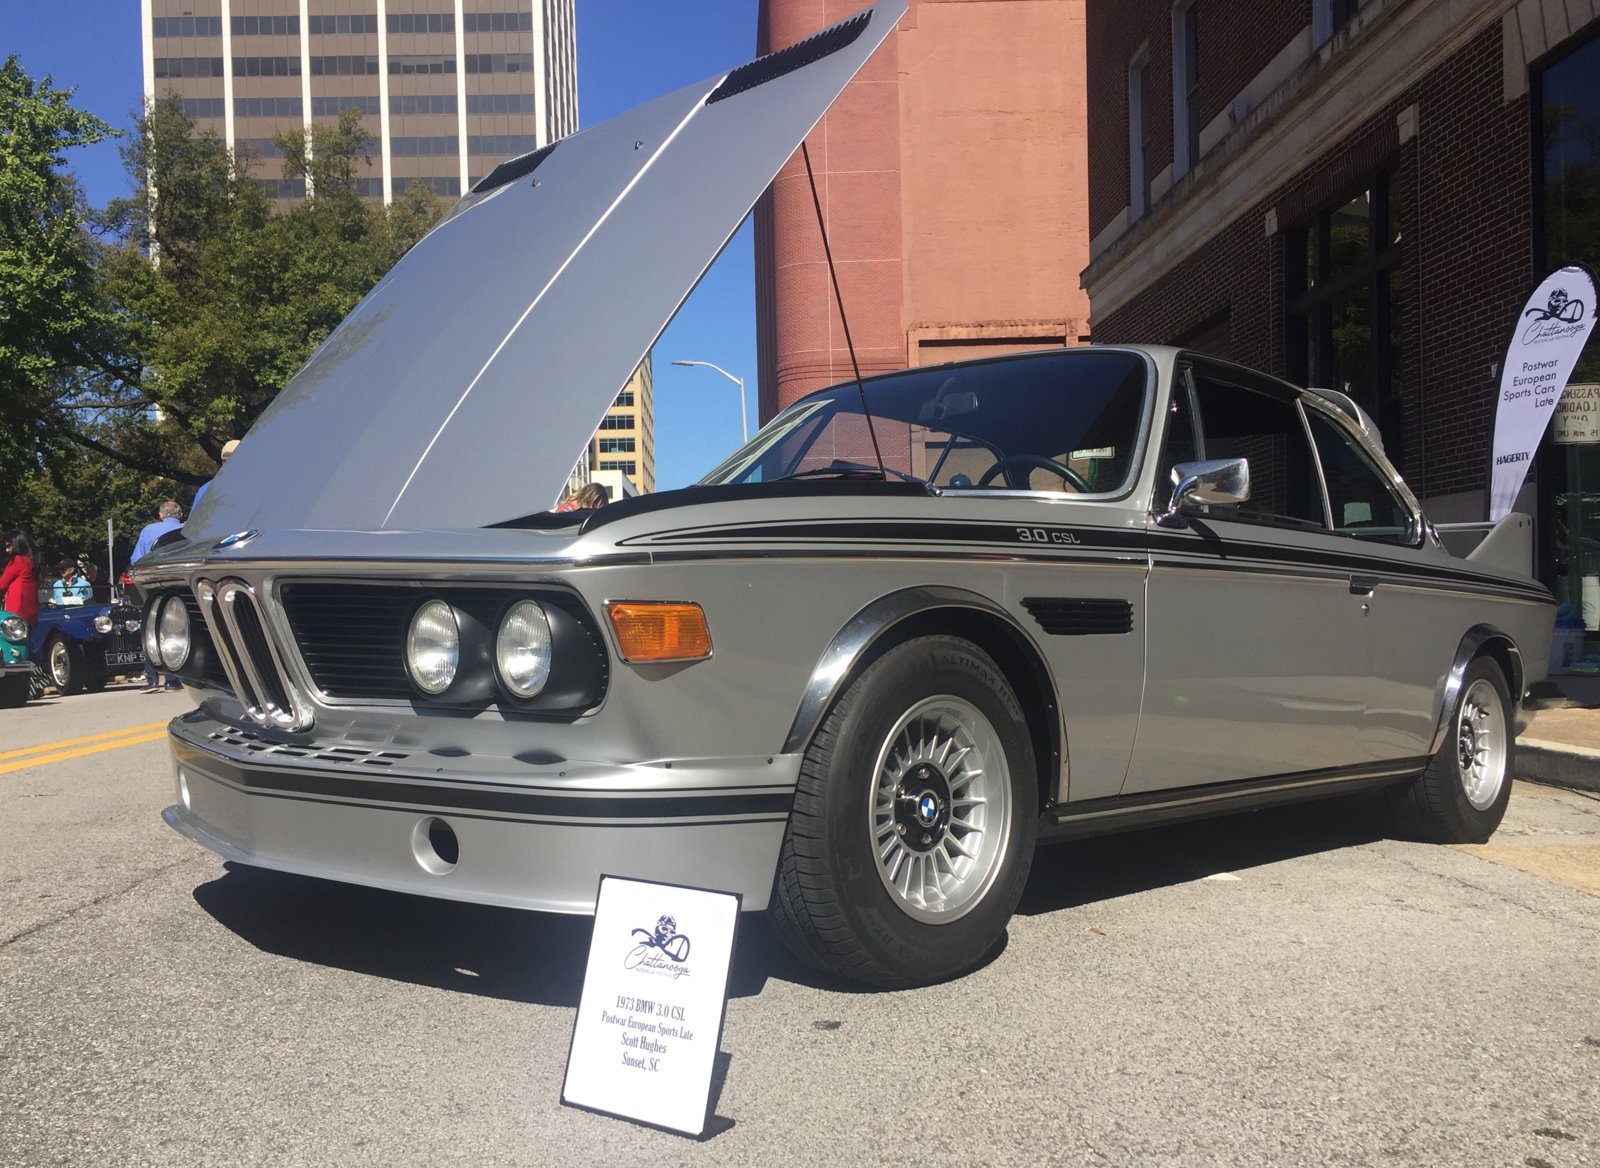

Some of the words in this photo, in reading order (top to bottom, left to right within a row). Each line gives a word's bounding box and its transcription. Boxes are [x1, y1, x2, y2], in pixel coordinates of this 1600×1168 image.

[1522, 320, 1586, 345] Chattanooga
[1522, 359, 1559, 373] Postwar
[1513, 372, 1557, 387] European
[1503, 388, 1532, 403] Sports
[1534, 384, 1556, 396] Cars
[1535, 397, 1554, 408] Late
[1496, 451, 1530, 466] HAGERTY
[1016, 527, 1049, 542] 3.0
[1051, 532, 1081, 544] CSL
[117, 653, 137, 663] KNP
[942, 655, 996, 684] ALTIMAX
[623, 944, 691, 980] Chattanooga
[616, 995, 635, 1011] 1973
[635, 998, 656, 1015] BMW
[656, 1003, 670, 1018] 3.0
[671, 1005, 685, 1021] CSL
[601, 1010, 627, 1026] Postwar
[627, 1015, 657, 1032] European
[657, 1022, 679, 1037] Sports
[679, 1026, 694, 1041] Late
[621, 1031, 639, 1048] Scott
[639, 1035, 667, 1054] Hughes
[648, 1057, 660, 1072] SC
